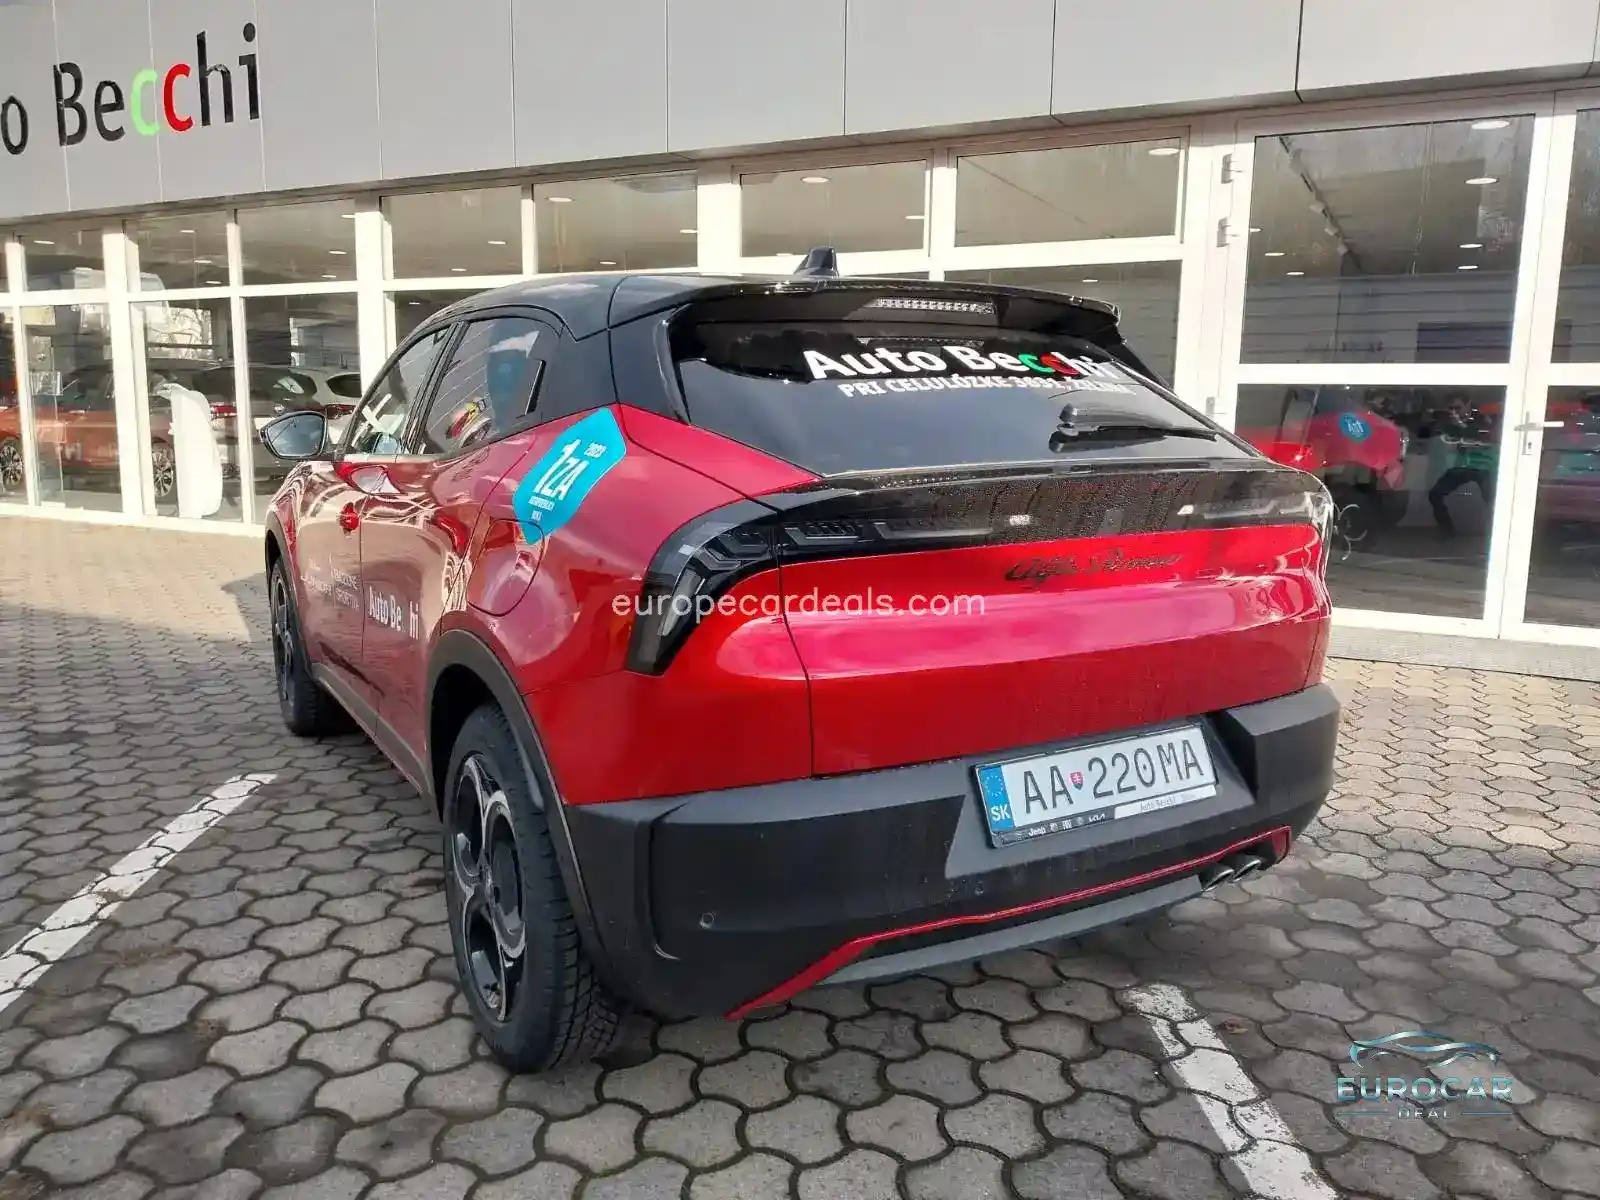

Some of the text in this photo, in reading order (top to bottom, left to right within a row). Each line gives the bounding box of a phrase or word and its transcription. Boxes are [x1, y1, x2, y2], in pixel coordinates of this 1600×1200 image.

[53, 22, 261, 147] Becchi
[803, 347, 947, 379] Auto
[838, 381, 887, 397] PRI
[368, 585, 389, 625] Auto
[390, 594, 419, 641] Behi
[1023, 739, 1205, 814] AA 220MA
[990, 803, 1011, 822] SK
